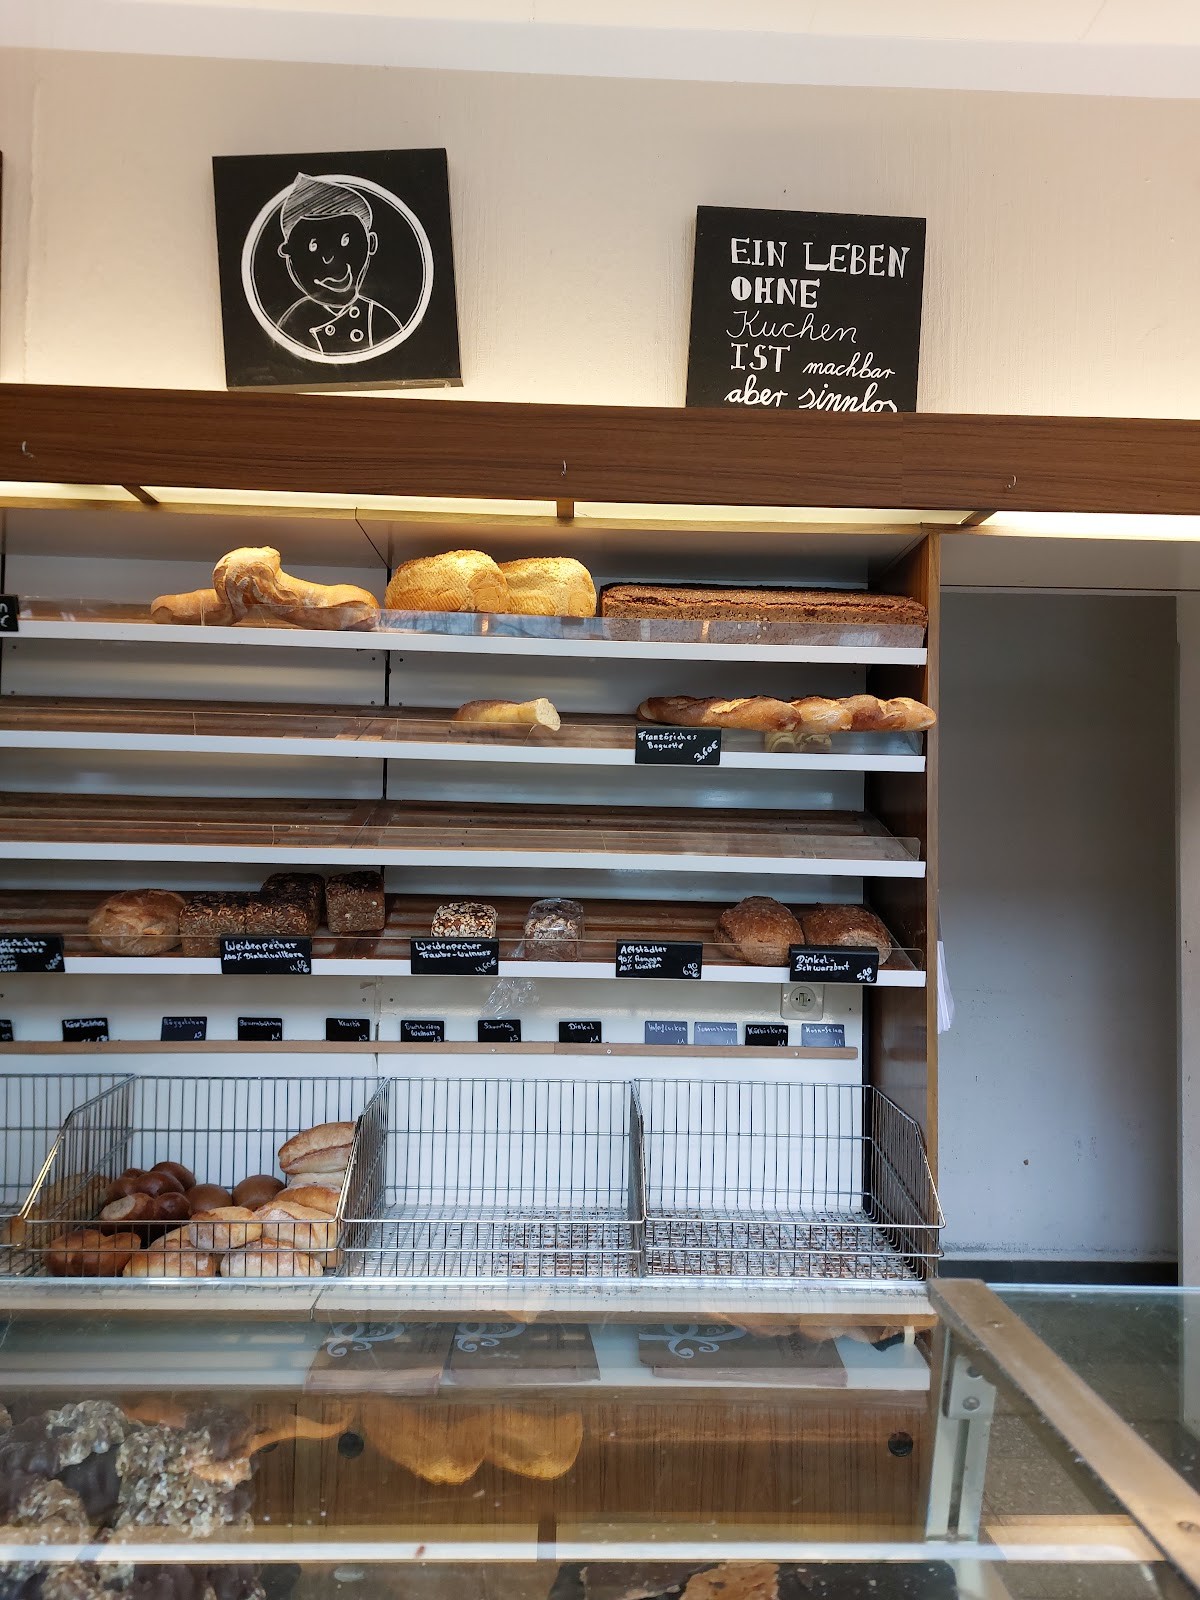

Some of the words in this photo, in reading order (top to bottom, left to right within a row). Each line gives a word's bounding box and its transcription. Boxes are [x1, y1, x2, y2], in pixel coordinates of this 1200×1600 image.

[731, 237, 787, 267] EIN
[803, 242, 910, 278] LEBEN
[731, 276, 821, 308] OHNE
[726, 310, 857, 343] Kuchen
[731, 342, 791, 372] IST
[802, 351, 896, 379] machbar
[724, 374, 788, 407] aber
[693, 740, 718, 762] 3,60€
[415, 942, 481, 951] Weidenpecher
